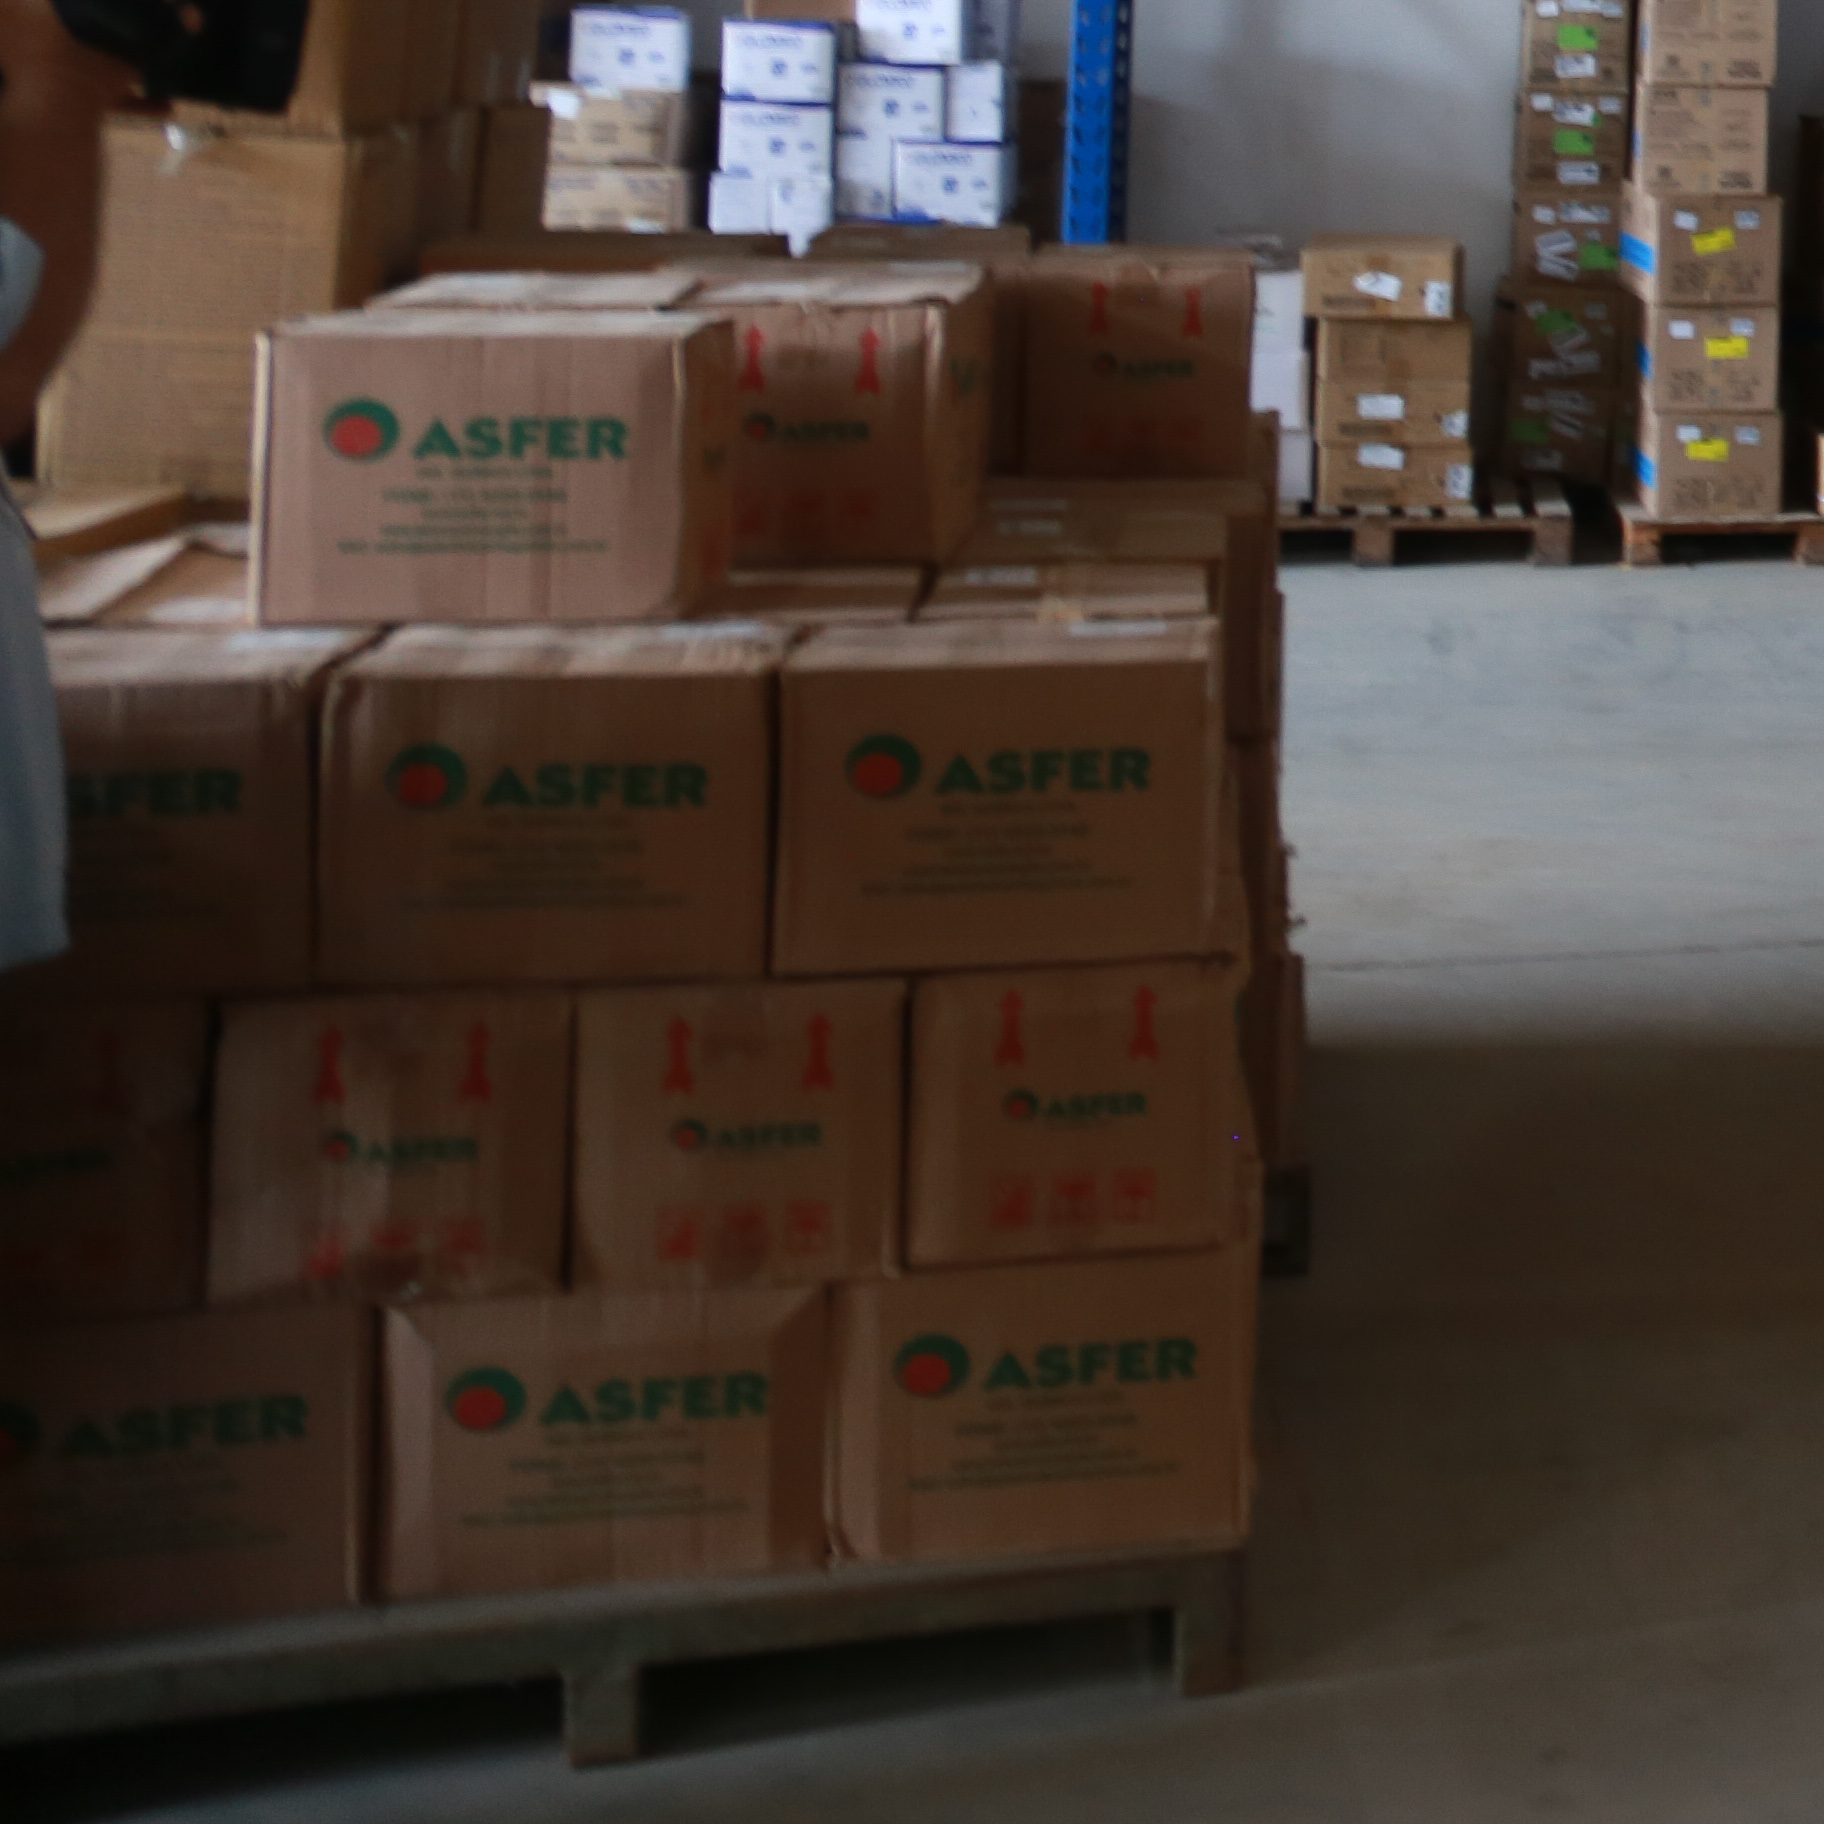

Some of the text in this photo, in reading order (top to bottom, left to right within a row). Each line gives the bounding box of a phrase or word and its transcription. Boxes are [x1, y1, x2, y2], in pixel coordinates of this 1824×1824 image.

[413, 416, 629, 462] ASFER
[483, 763, 707, 808] ASFER
[938, 748, 1151, 795] ASFER
[1039, 1091, 1148, 1122] ASFER
[362, 1134, 479, 1166] ASFER
[713, 1120, 823, 1151] ASFER
[984, 1337, 1198, 1391] ASFER
[540, 1372, 770, 1427] ASFER
[65, 1395, 308, 1458] ASFER
